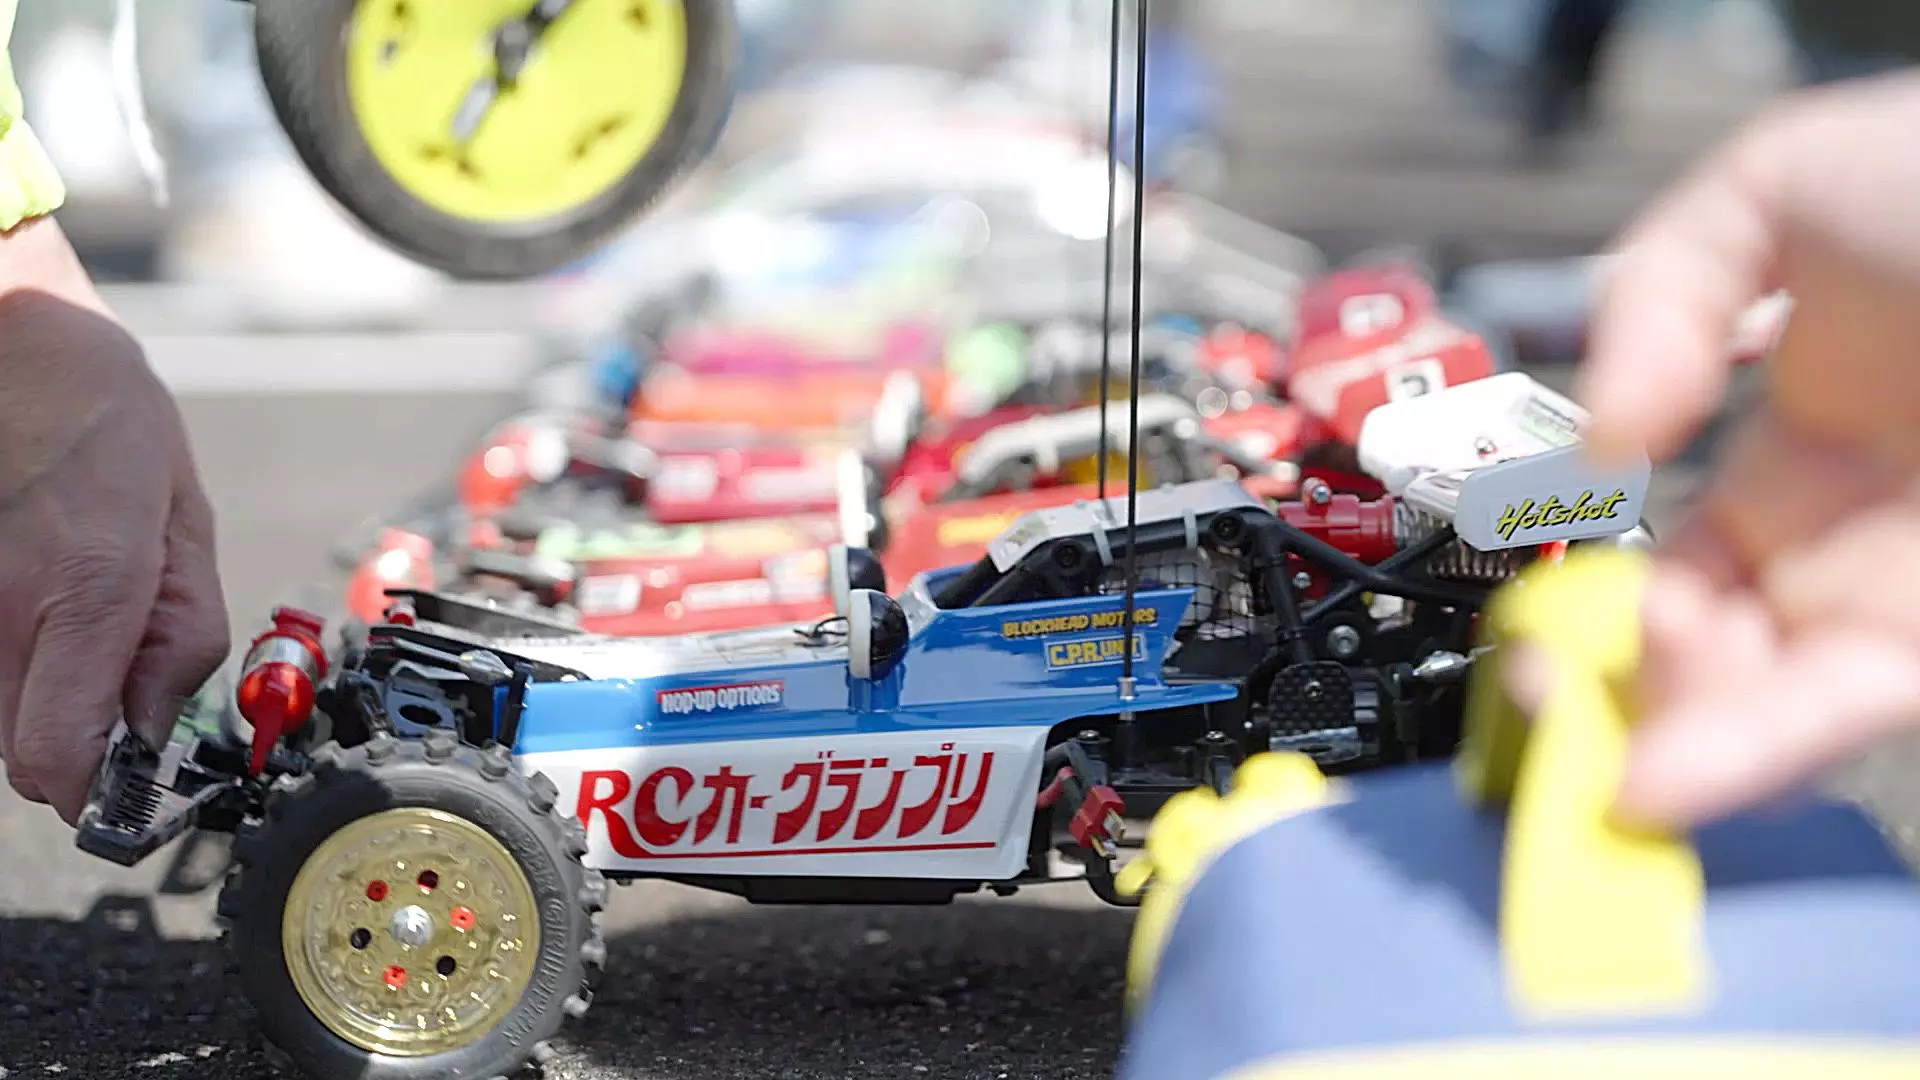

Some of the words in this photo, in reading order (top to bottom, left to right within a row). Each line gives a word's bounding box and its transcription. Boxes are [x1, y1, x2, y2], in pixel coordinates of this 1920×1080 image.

[1495, 489, 1627, 541] Hotshot
[1002, 614, 1089, 637] BLOCKHEAD
[1091, 607, 1157, 628] MOTRS
[661, 690, 716, 714] HOP-UP
[717, 684, 781, 710] OPTIONS
[576, 742, 997, 858] RCカーグランプリ
